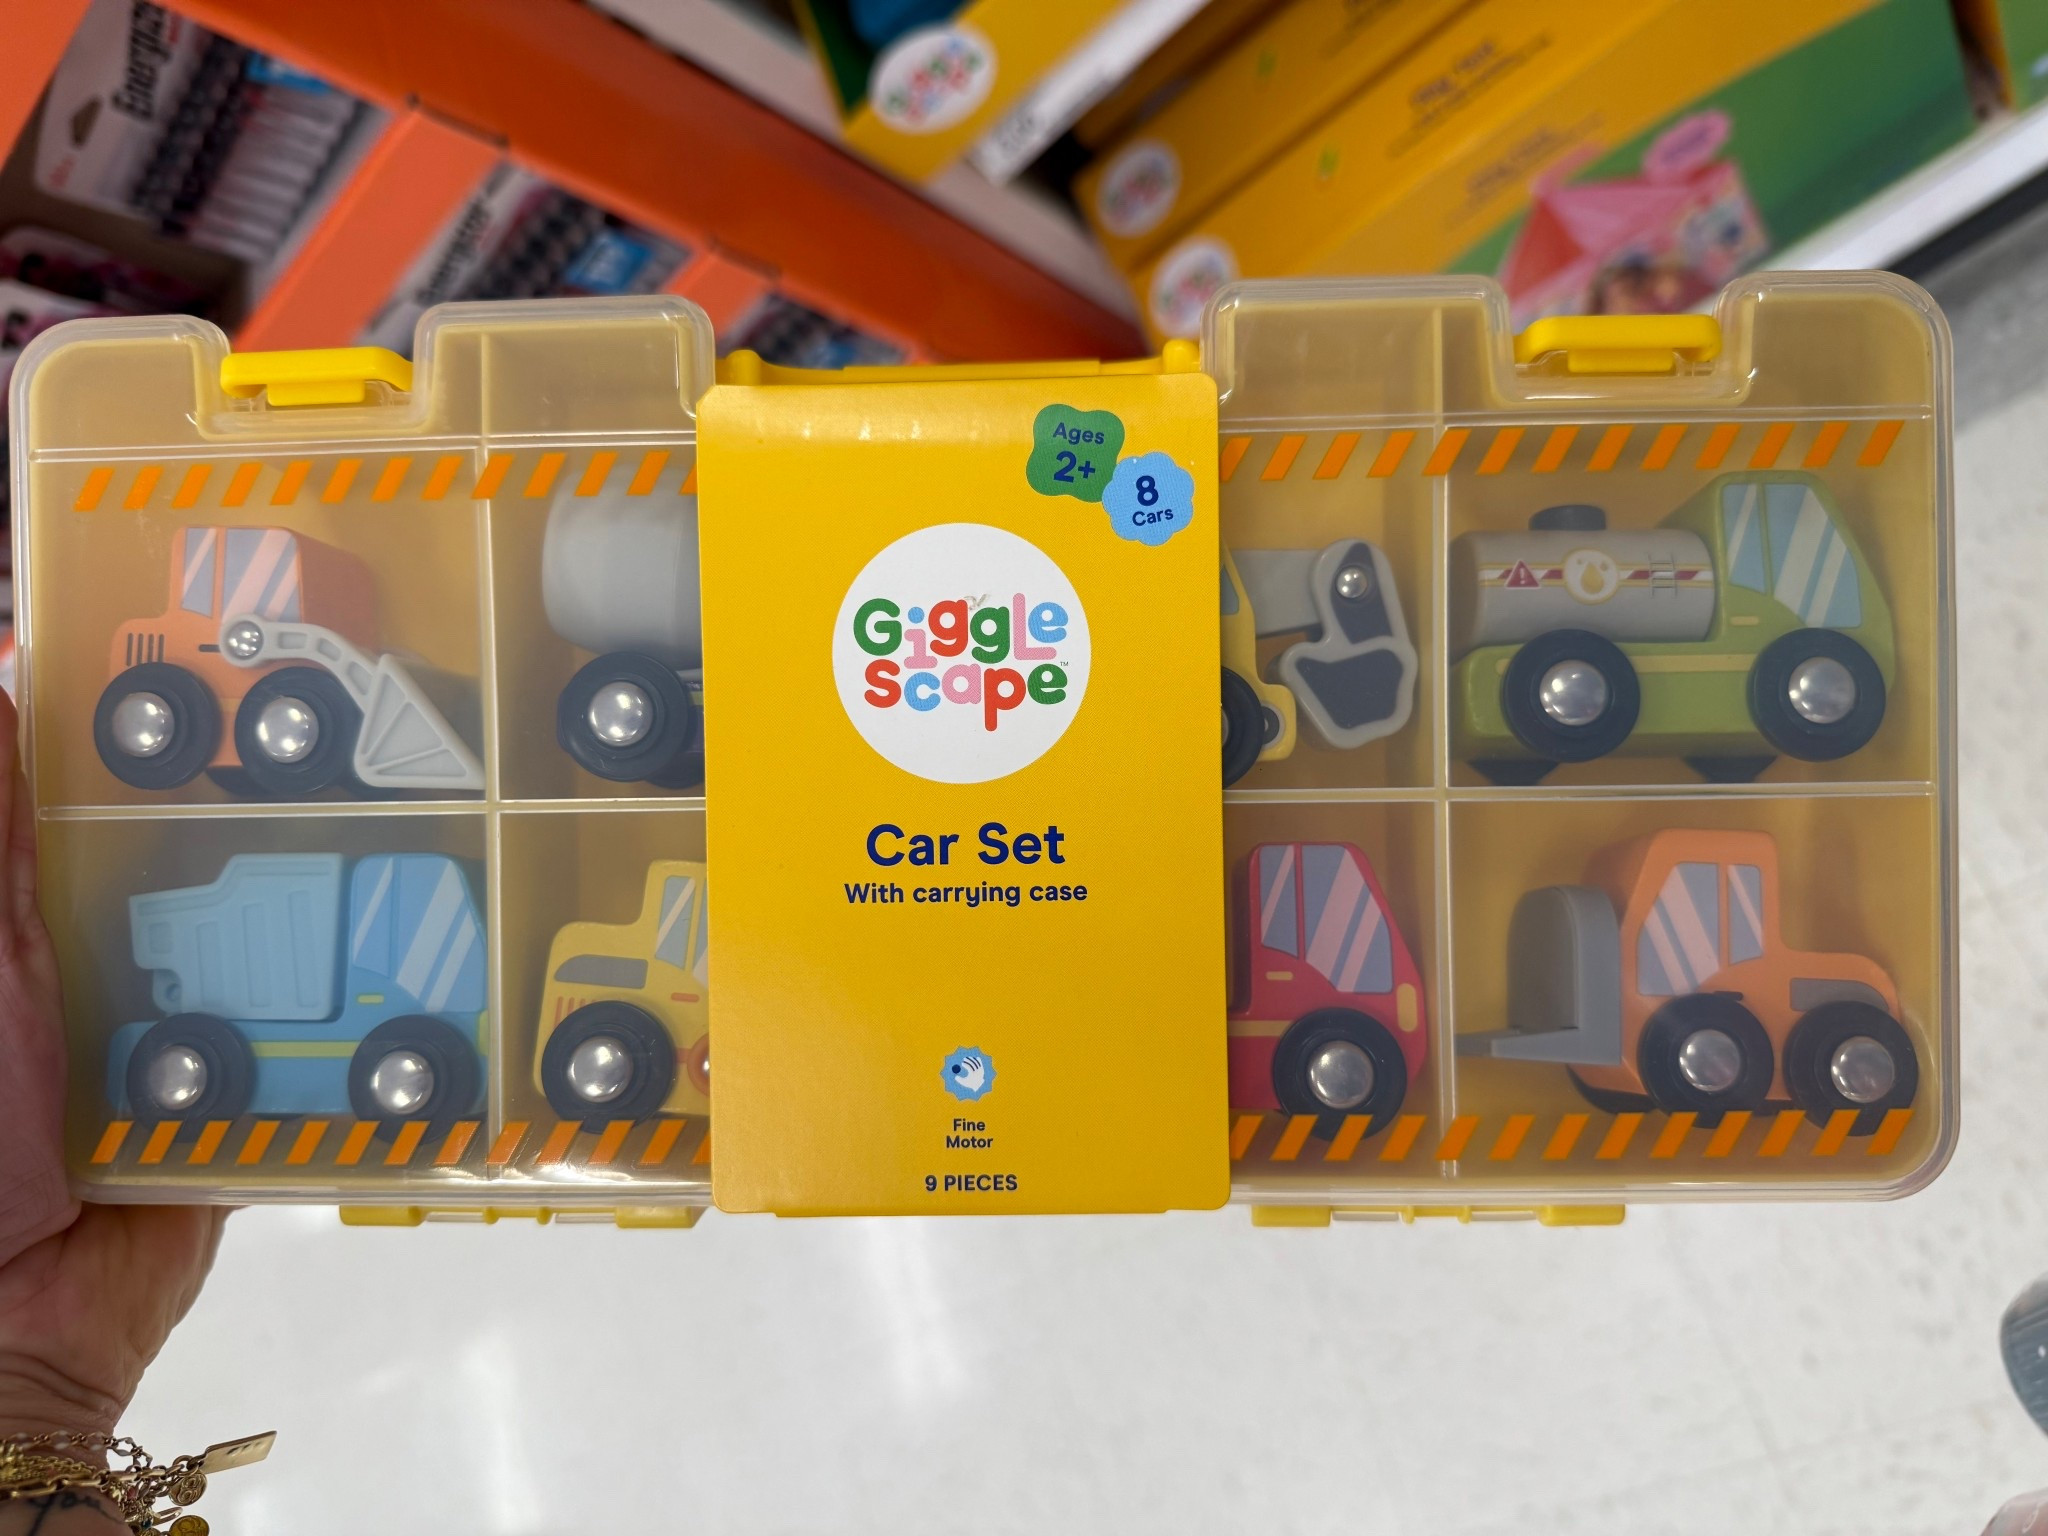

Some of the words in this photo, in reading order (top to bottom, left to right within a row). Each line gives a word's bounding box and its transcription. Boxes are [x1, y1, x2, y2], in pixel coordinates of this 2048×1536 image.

[1053, 422, 1105, 445] Ages
[1053, 450, 1096, 483] 2+
[1135, 475, 1159, 507] 8
[1131, 508, 1174, 527] Cars
[866, 824, 960, 867] Car
[977, 821, 1066, 866] Set
[844, 882, 904, 904] With
[912, 881, 1021, 908] carrying
[1029, 884, 1088, 902] case
[952, 1118, 986, 1132] Fine
[945, 1135, 994, 1149] Motor
[924, 1174, 938, 1192] 9
[944, 1174, 1018, 1192] PIECES
